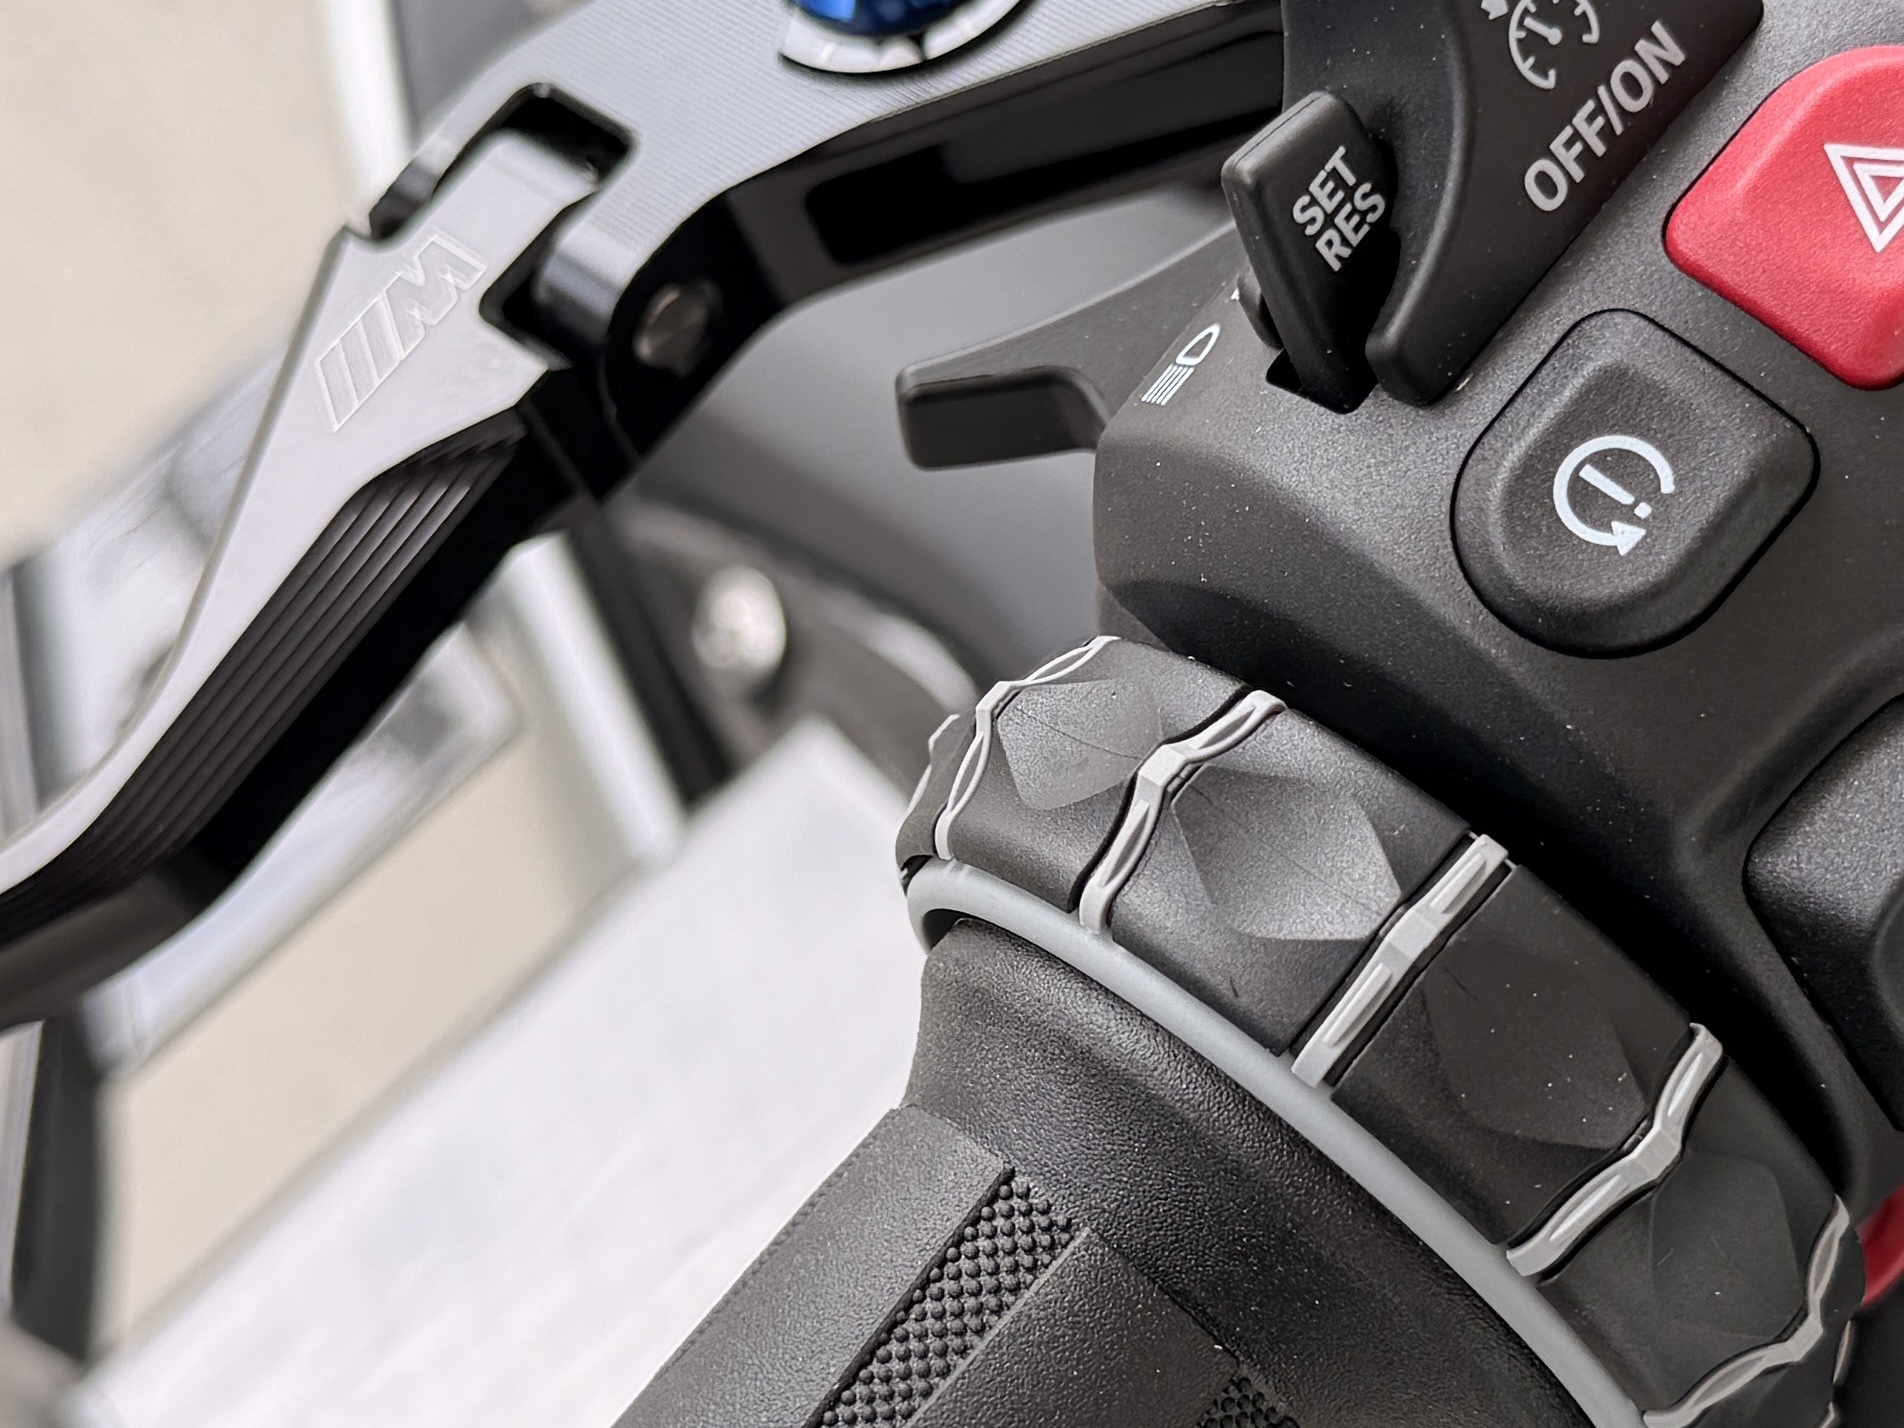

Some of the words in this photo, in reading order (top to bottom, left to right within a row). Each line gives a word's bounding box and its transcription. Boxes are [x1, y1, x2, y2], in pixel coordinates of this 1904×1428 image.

[1524, 20, 1686, 212] OFF/ON
[1292, 145, 1358, 236] SET
[1315, 182, 1386, 272] RES
